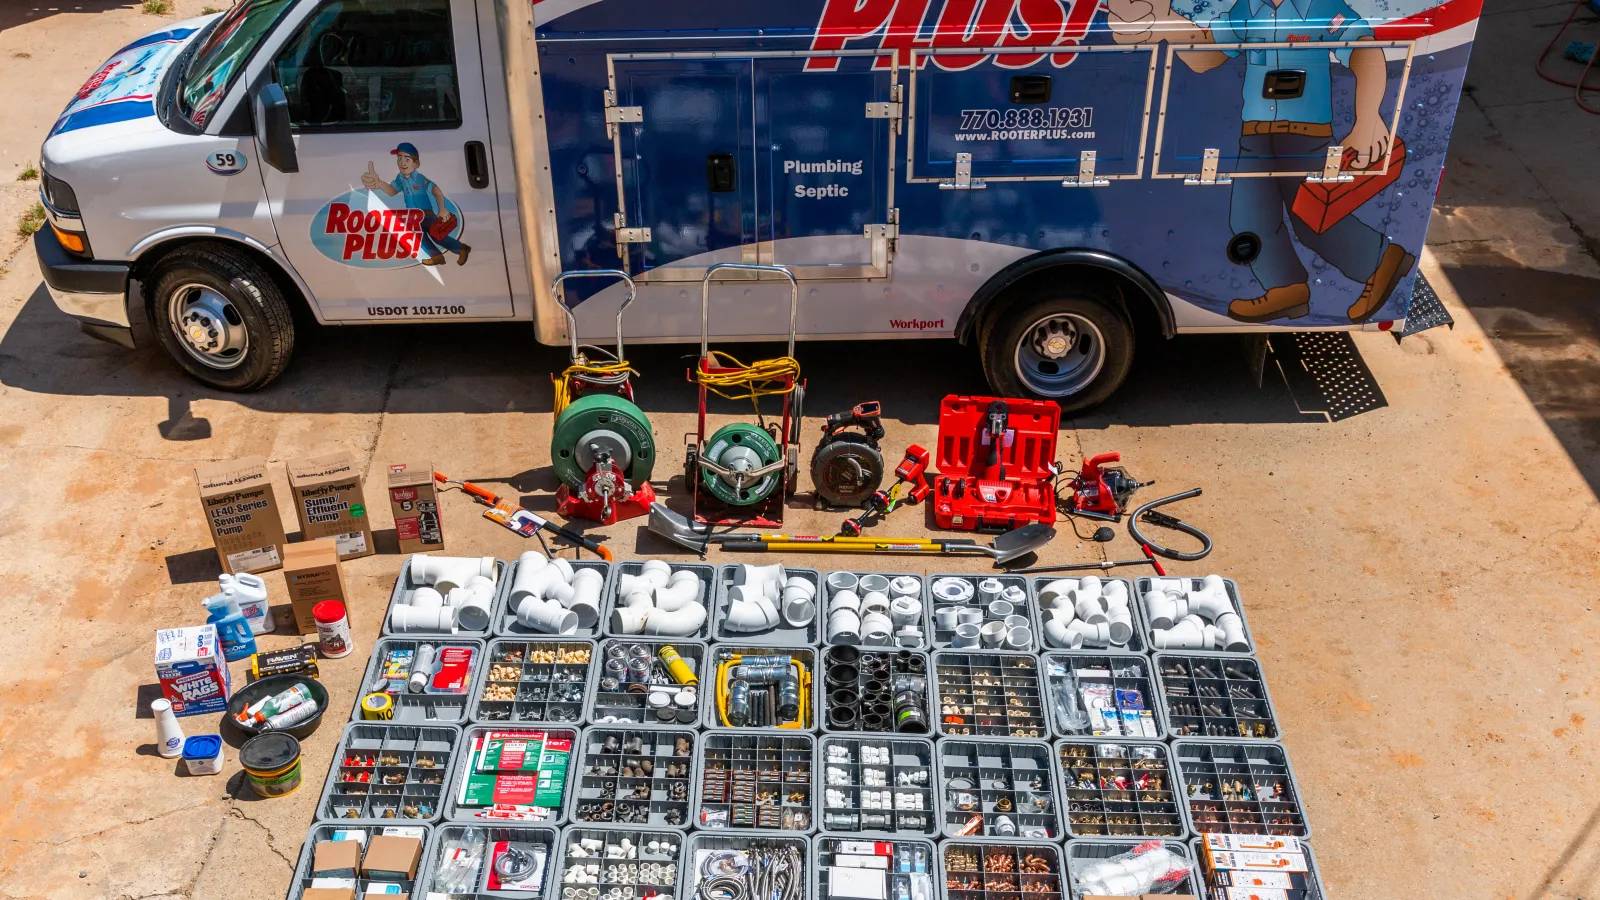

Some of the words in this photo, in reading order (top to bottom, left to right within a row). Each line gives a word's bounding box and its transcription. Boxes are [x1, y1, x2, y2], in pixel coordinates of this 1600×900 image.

[802, 0, 1105, 72] PLUS!
[959, 107, 1094, 130] 770.888.1931
[954, 128, 1096, 142] www.ROOTERPLUS.com
[215, 153, 236, 167] 59
[783, 159, 863, 175] Plumbing
[794, 184, 849, 200] Septic
[325, 202, 425, 234] ROOTER
[342, 232, 424, 261] PLUS!
[367, 306, 409, 316] USDOT
[412, 305, 466, 315] 1017100
[889, 318, 945, 331] Workport
[301, 486, 328, 497] Liberty
[328, 482, 356, 493] Pumps
[206, 494, 236, 506] Liberty
[235, 489, 265, 501] Pumps
[304, 494, 339, 508] Sump/
[210, 499, 268, 518] LE40-Series
[306, 501, 349, 515] Effluent
[402, 501, 412, 511] 5
[213, 512, 252, 528] Sewage
[308, 512, 340, 524] Pump
[216, 524, 244, 537] Pump
[297, 571, 331, 580] HYDRAPRO
[266, 654, 297, 664] RAVEN
[170, 676, 213, 693] WHITE
[177, 672, 209, 683] PROFESSIONAL
[182, 682, 219, 701] RAGS
[376, 708, 394, 720] NO
